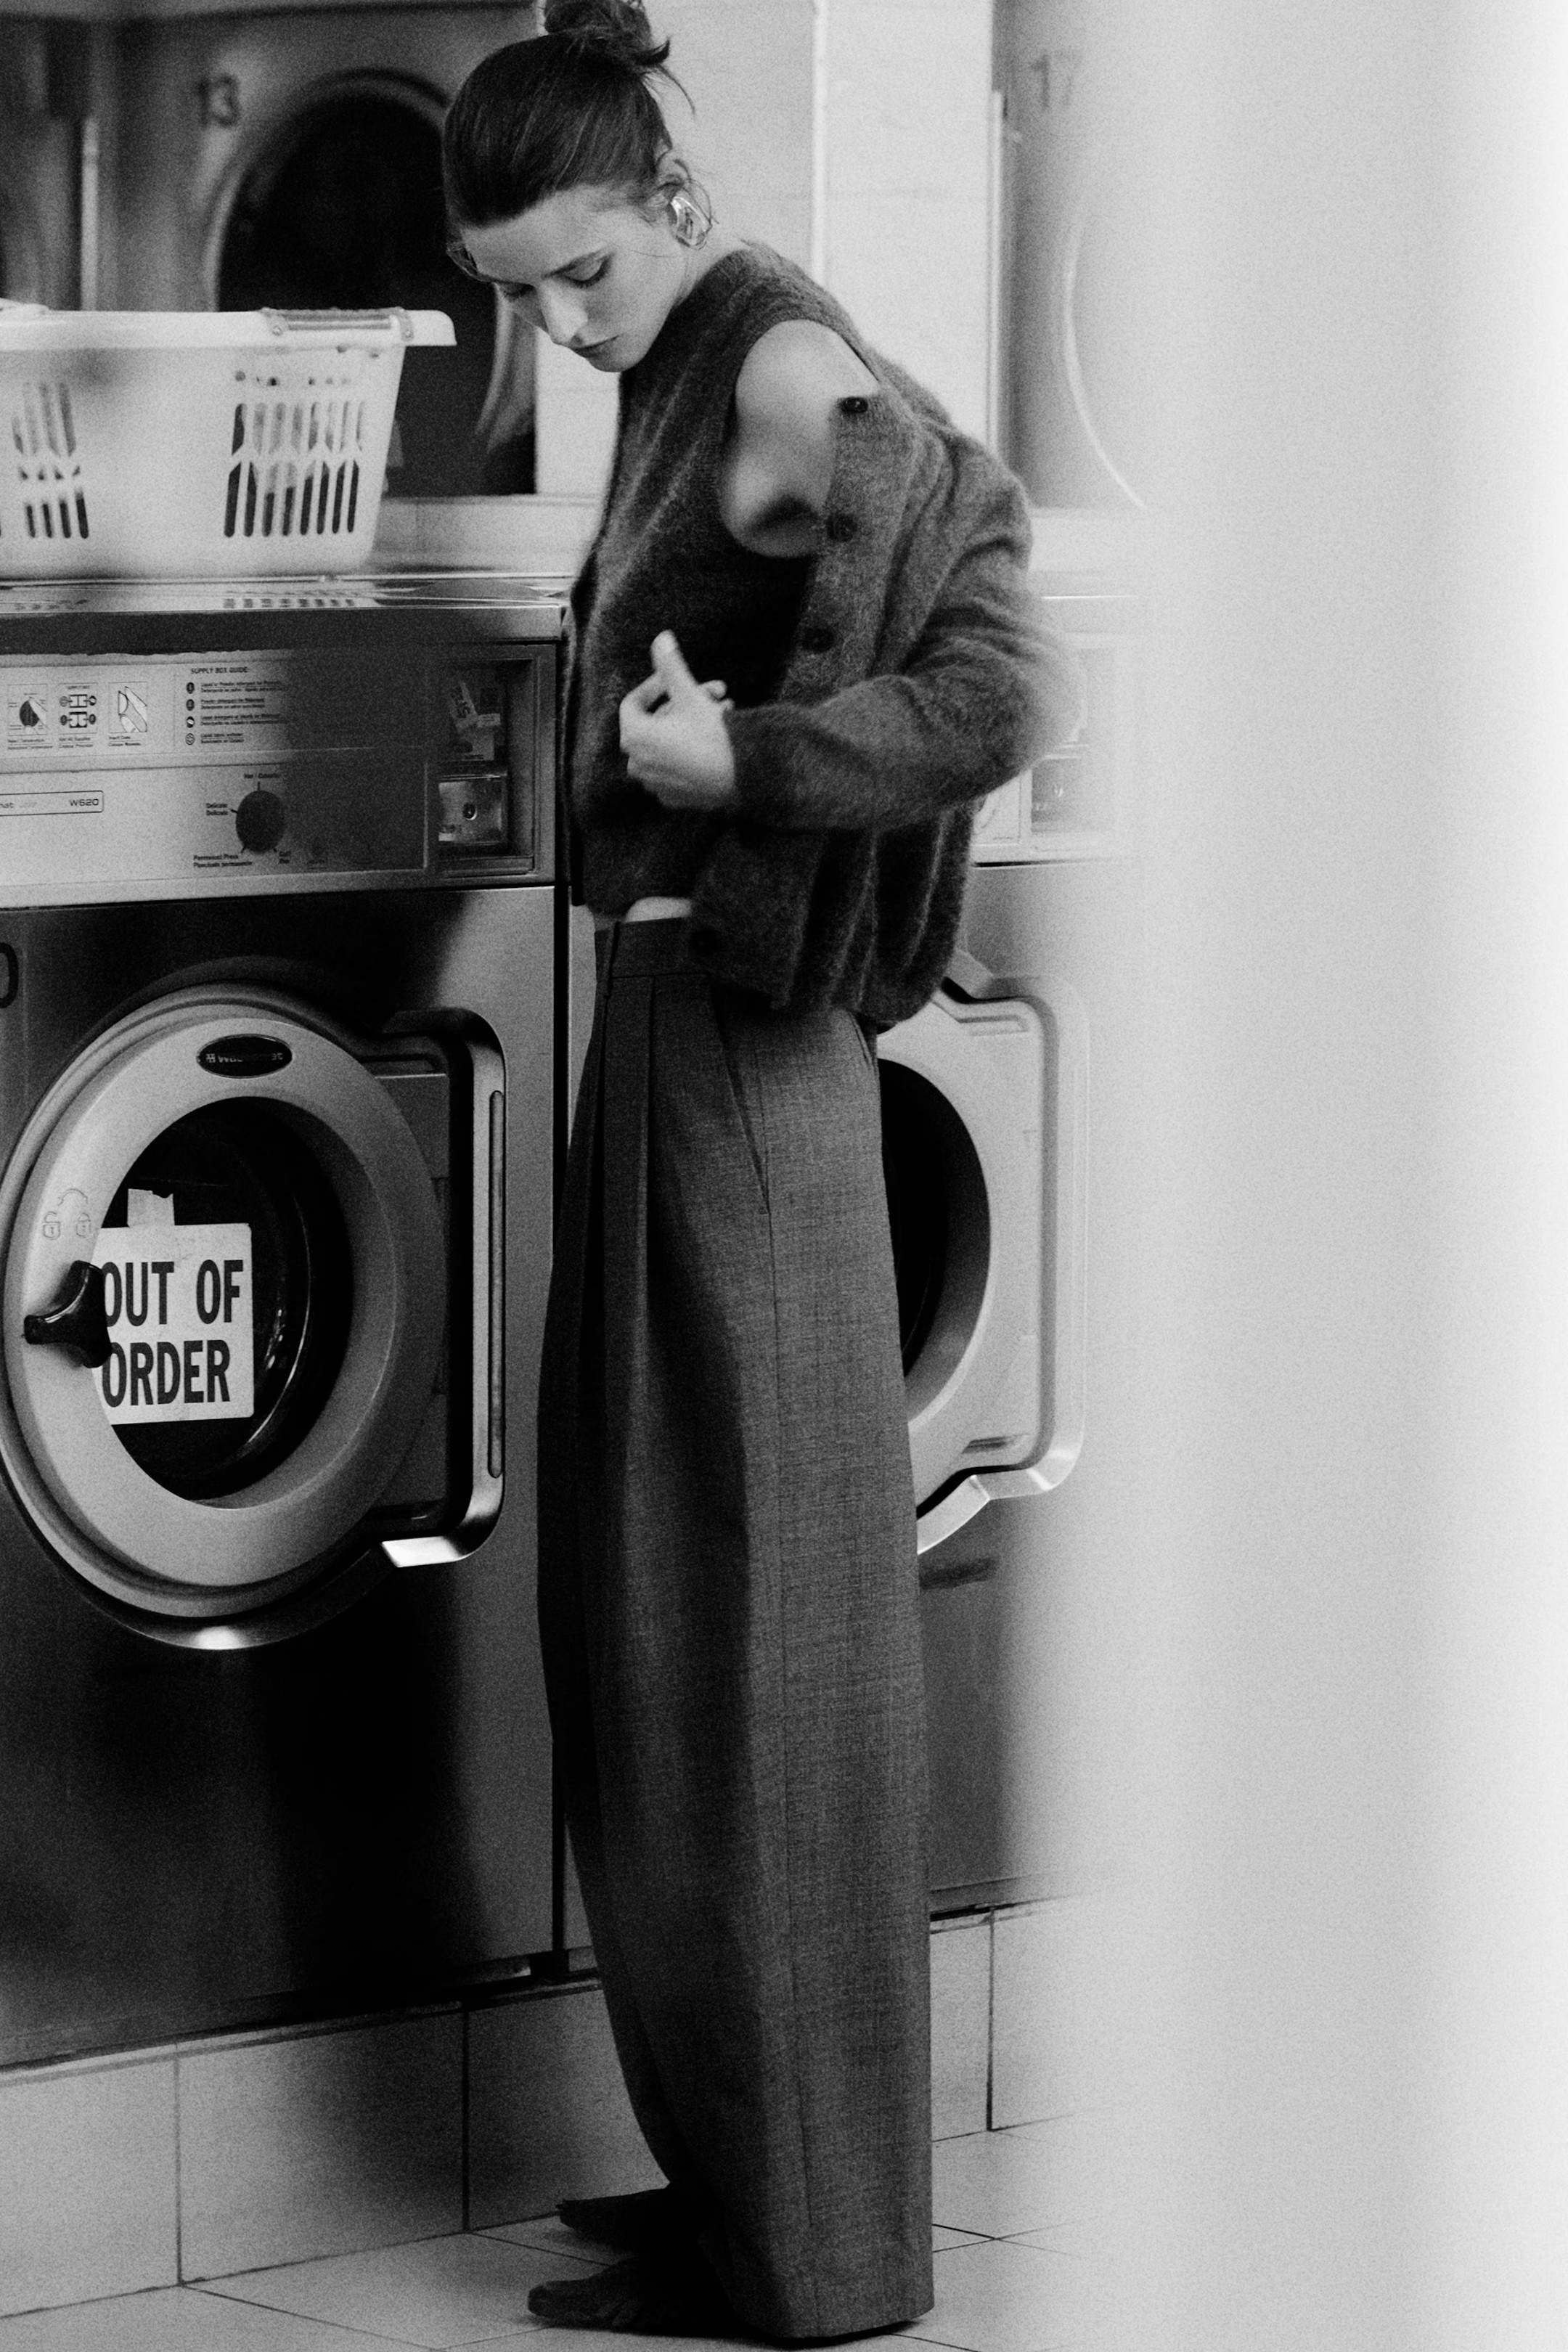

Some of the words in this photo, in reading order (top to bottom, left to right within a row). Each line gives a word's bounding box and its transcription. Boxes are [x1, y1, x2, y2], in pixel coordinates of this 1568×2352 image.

[195, 74, 240, 128] 13
[102, 1261, 174, 1327] OUT
[196, 1259, 244, 1325] OF
[102, 1340, 231, 1408] ORDER
